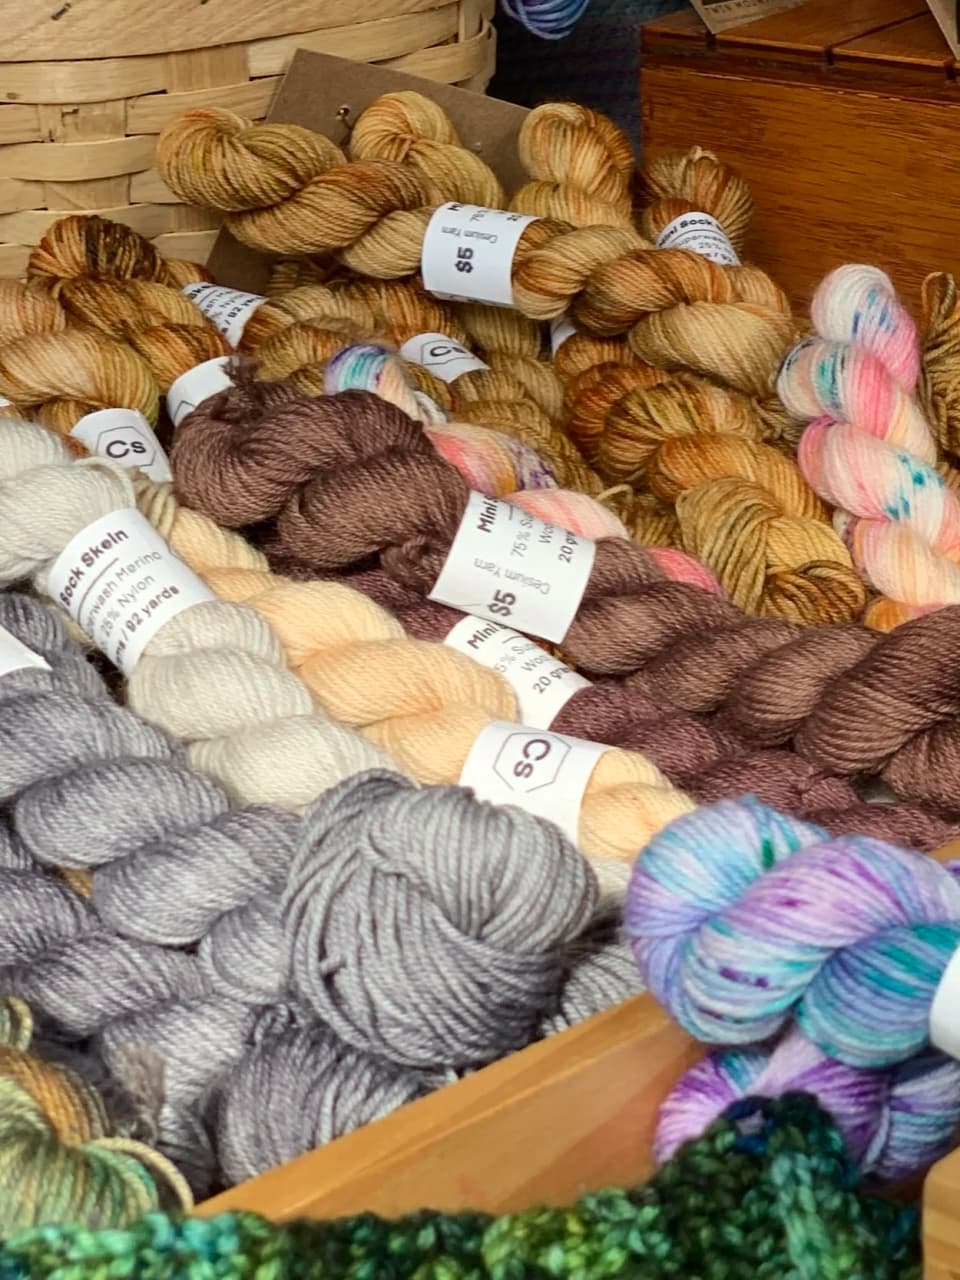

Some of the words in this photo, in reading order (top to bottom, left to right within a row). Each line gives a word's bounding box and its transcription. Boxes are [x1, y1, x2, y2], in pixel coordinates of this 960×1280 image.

[704, 3, 732, 15] TWIN
[679, 219, 713, 229] Sock
[454, 246, 474, 274] $5
[105, 440, 147, 459] Cs
[477, 501, 499, 533] Mini
[81, 528, 130, 568] Skein
[510, 532, 531, 558] 75%
[558, 545, 575, 564] 20
[115, 551, 163, 583] Merino
[473, 557, 502, 578] Yarn
[117, 575, 156, 608] Nylon
[504, 567, 551, 596] Cesium
[141, 585, 180, 617] yards
[487, 589, 516, 617] $5
[466, 622, 498, 649] Mini
[532, 675, 551, 694] 20
[513, 738, 551, 779] Cs
